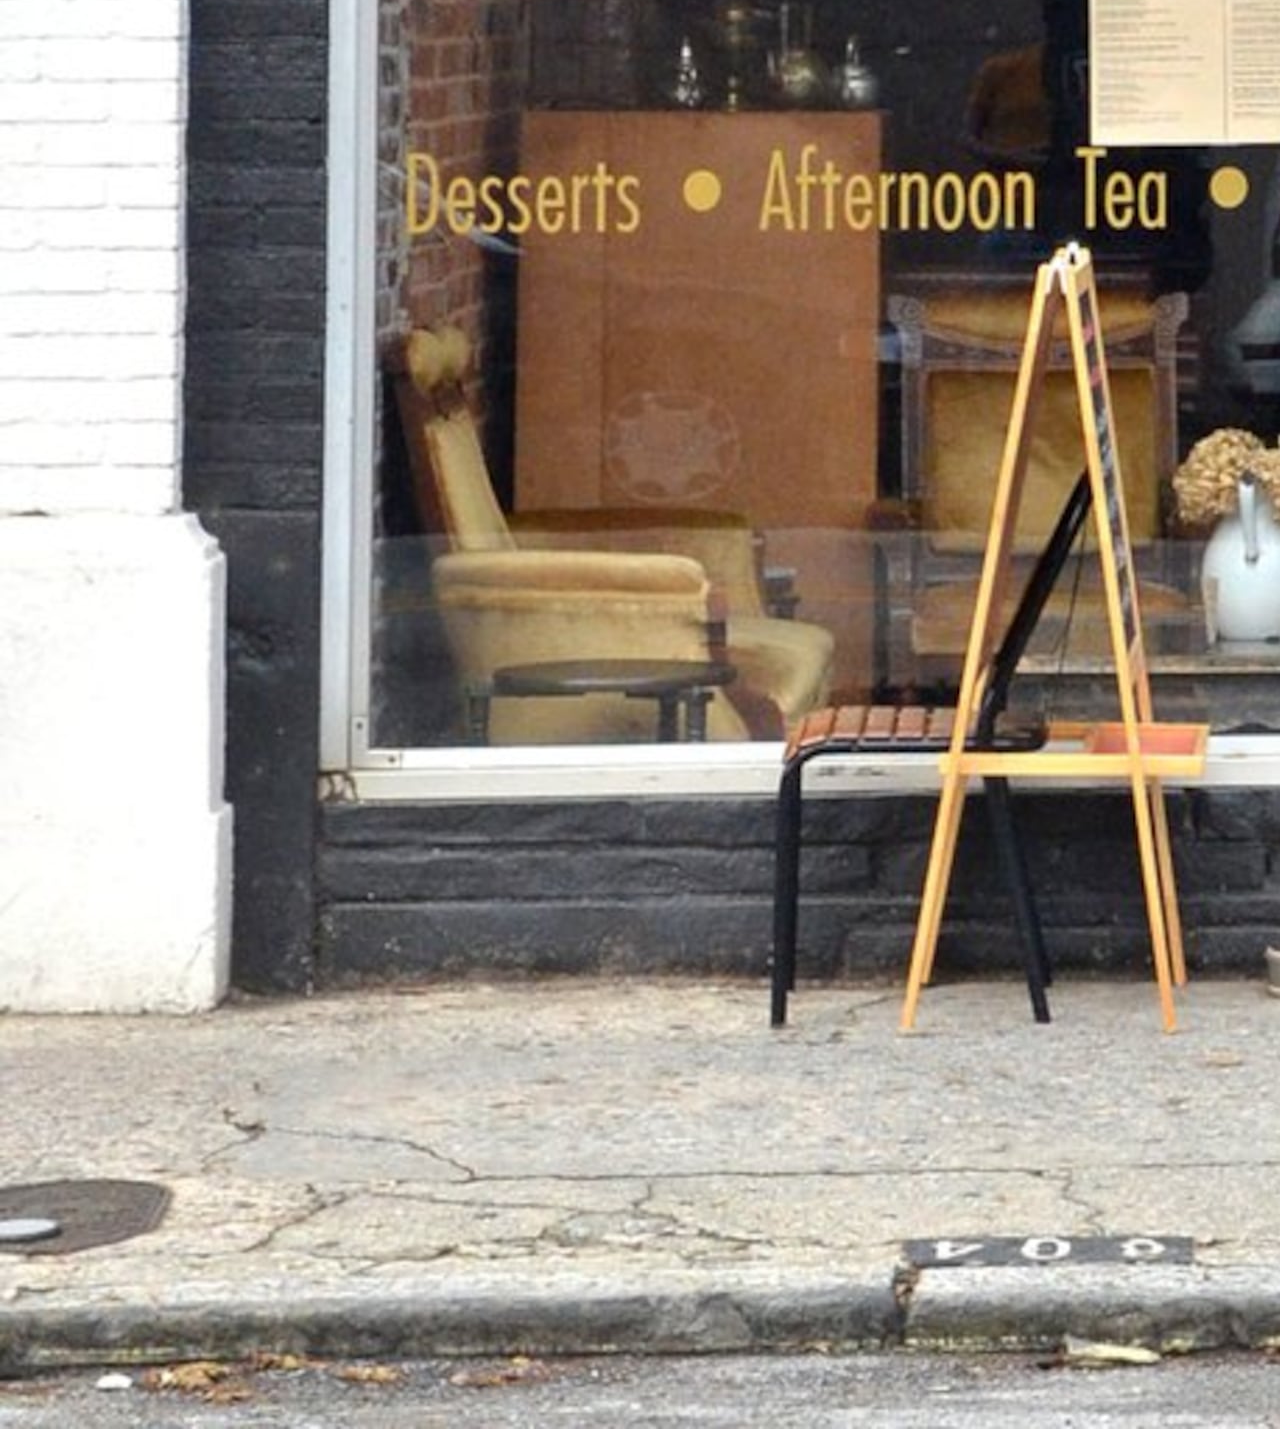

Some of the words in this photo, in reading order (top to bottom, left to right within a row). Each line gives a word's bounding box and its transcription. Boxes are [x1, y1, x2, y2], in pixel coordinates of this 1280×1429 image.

[405, 151, 641, 235] Desserts
[759, 144, 1036, 231] Afternoon
[1075, 147, 1167, 229] Tea
